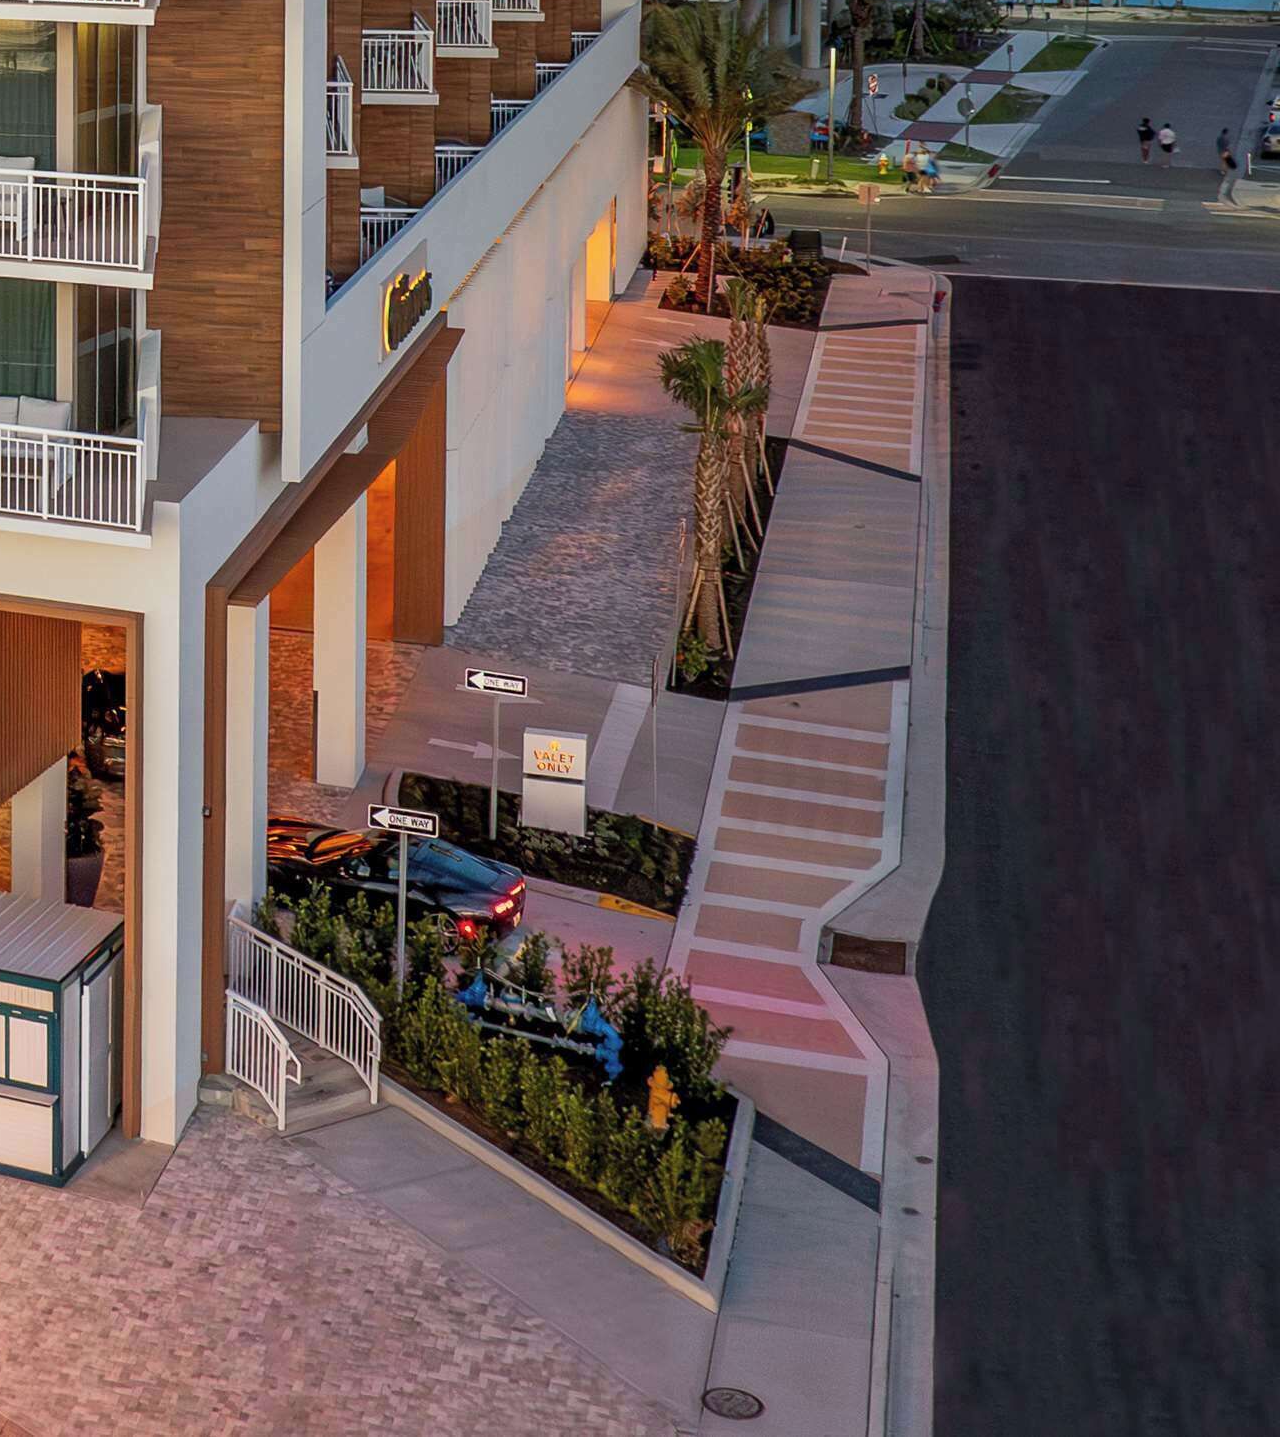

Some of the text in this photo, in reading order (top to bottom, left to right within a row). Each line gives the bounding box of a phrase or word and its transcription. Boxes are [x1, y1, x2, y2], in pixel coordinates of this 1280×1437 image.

[483, 678, 521, 689] ONE WAY
[533, 750, 575, 763] VALET
[537, 762, 571, 774] ONLY
[389, 814, 429, 828] ONE WAY
